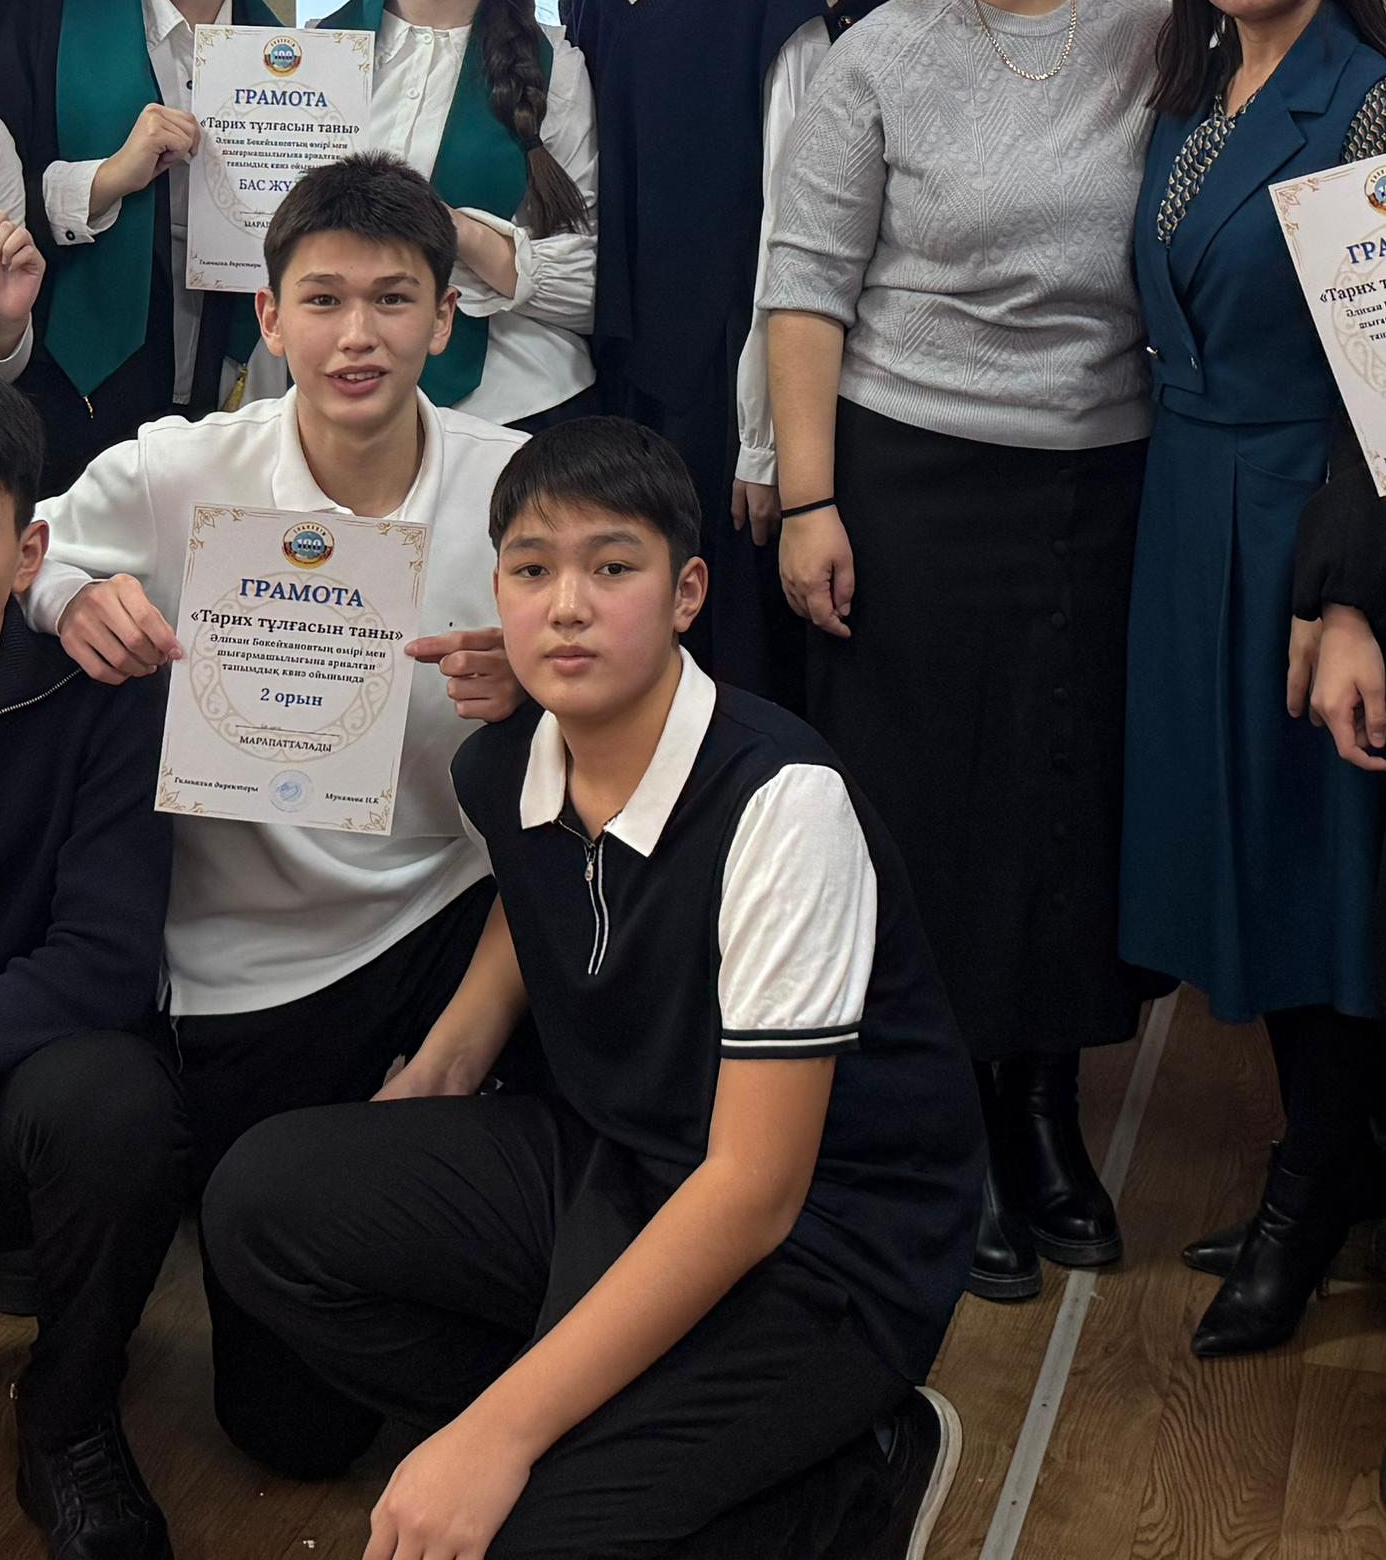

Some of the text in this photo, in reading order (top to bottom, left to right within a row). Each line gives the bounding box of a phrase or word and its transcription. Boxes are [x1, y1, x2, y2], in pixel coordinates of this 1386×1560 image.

[235, 88, 328, 107] ГРАМОТА
[200, 117, 360, 135] «Тарих тұлғасын таны»
[239, 178, 266, 191] БАС
[1319, 280, 1377, 304] «Тарих
[239, 578, 364, 608] ГРАМОТА
[191, 609, 404, 642] «Тарих тұлғасын таны»
[260, 688, 323, 707] 2 орын
[239, 736, 332, 753] МАРАПАТТАЛАДЫ
